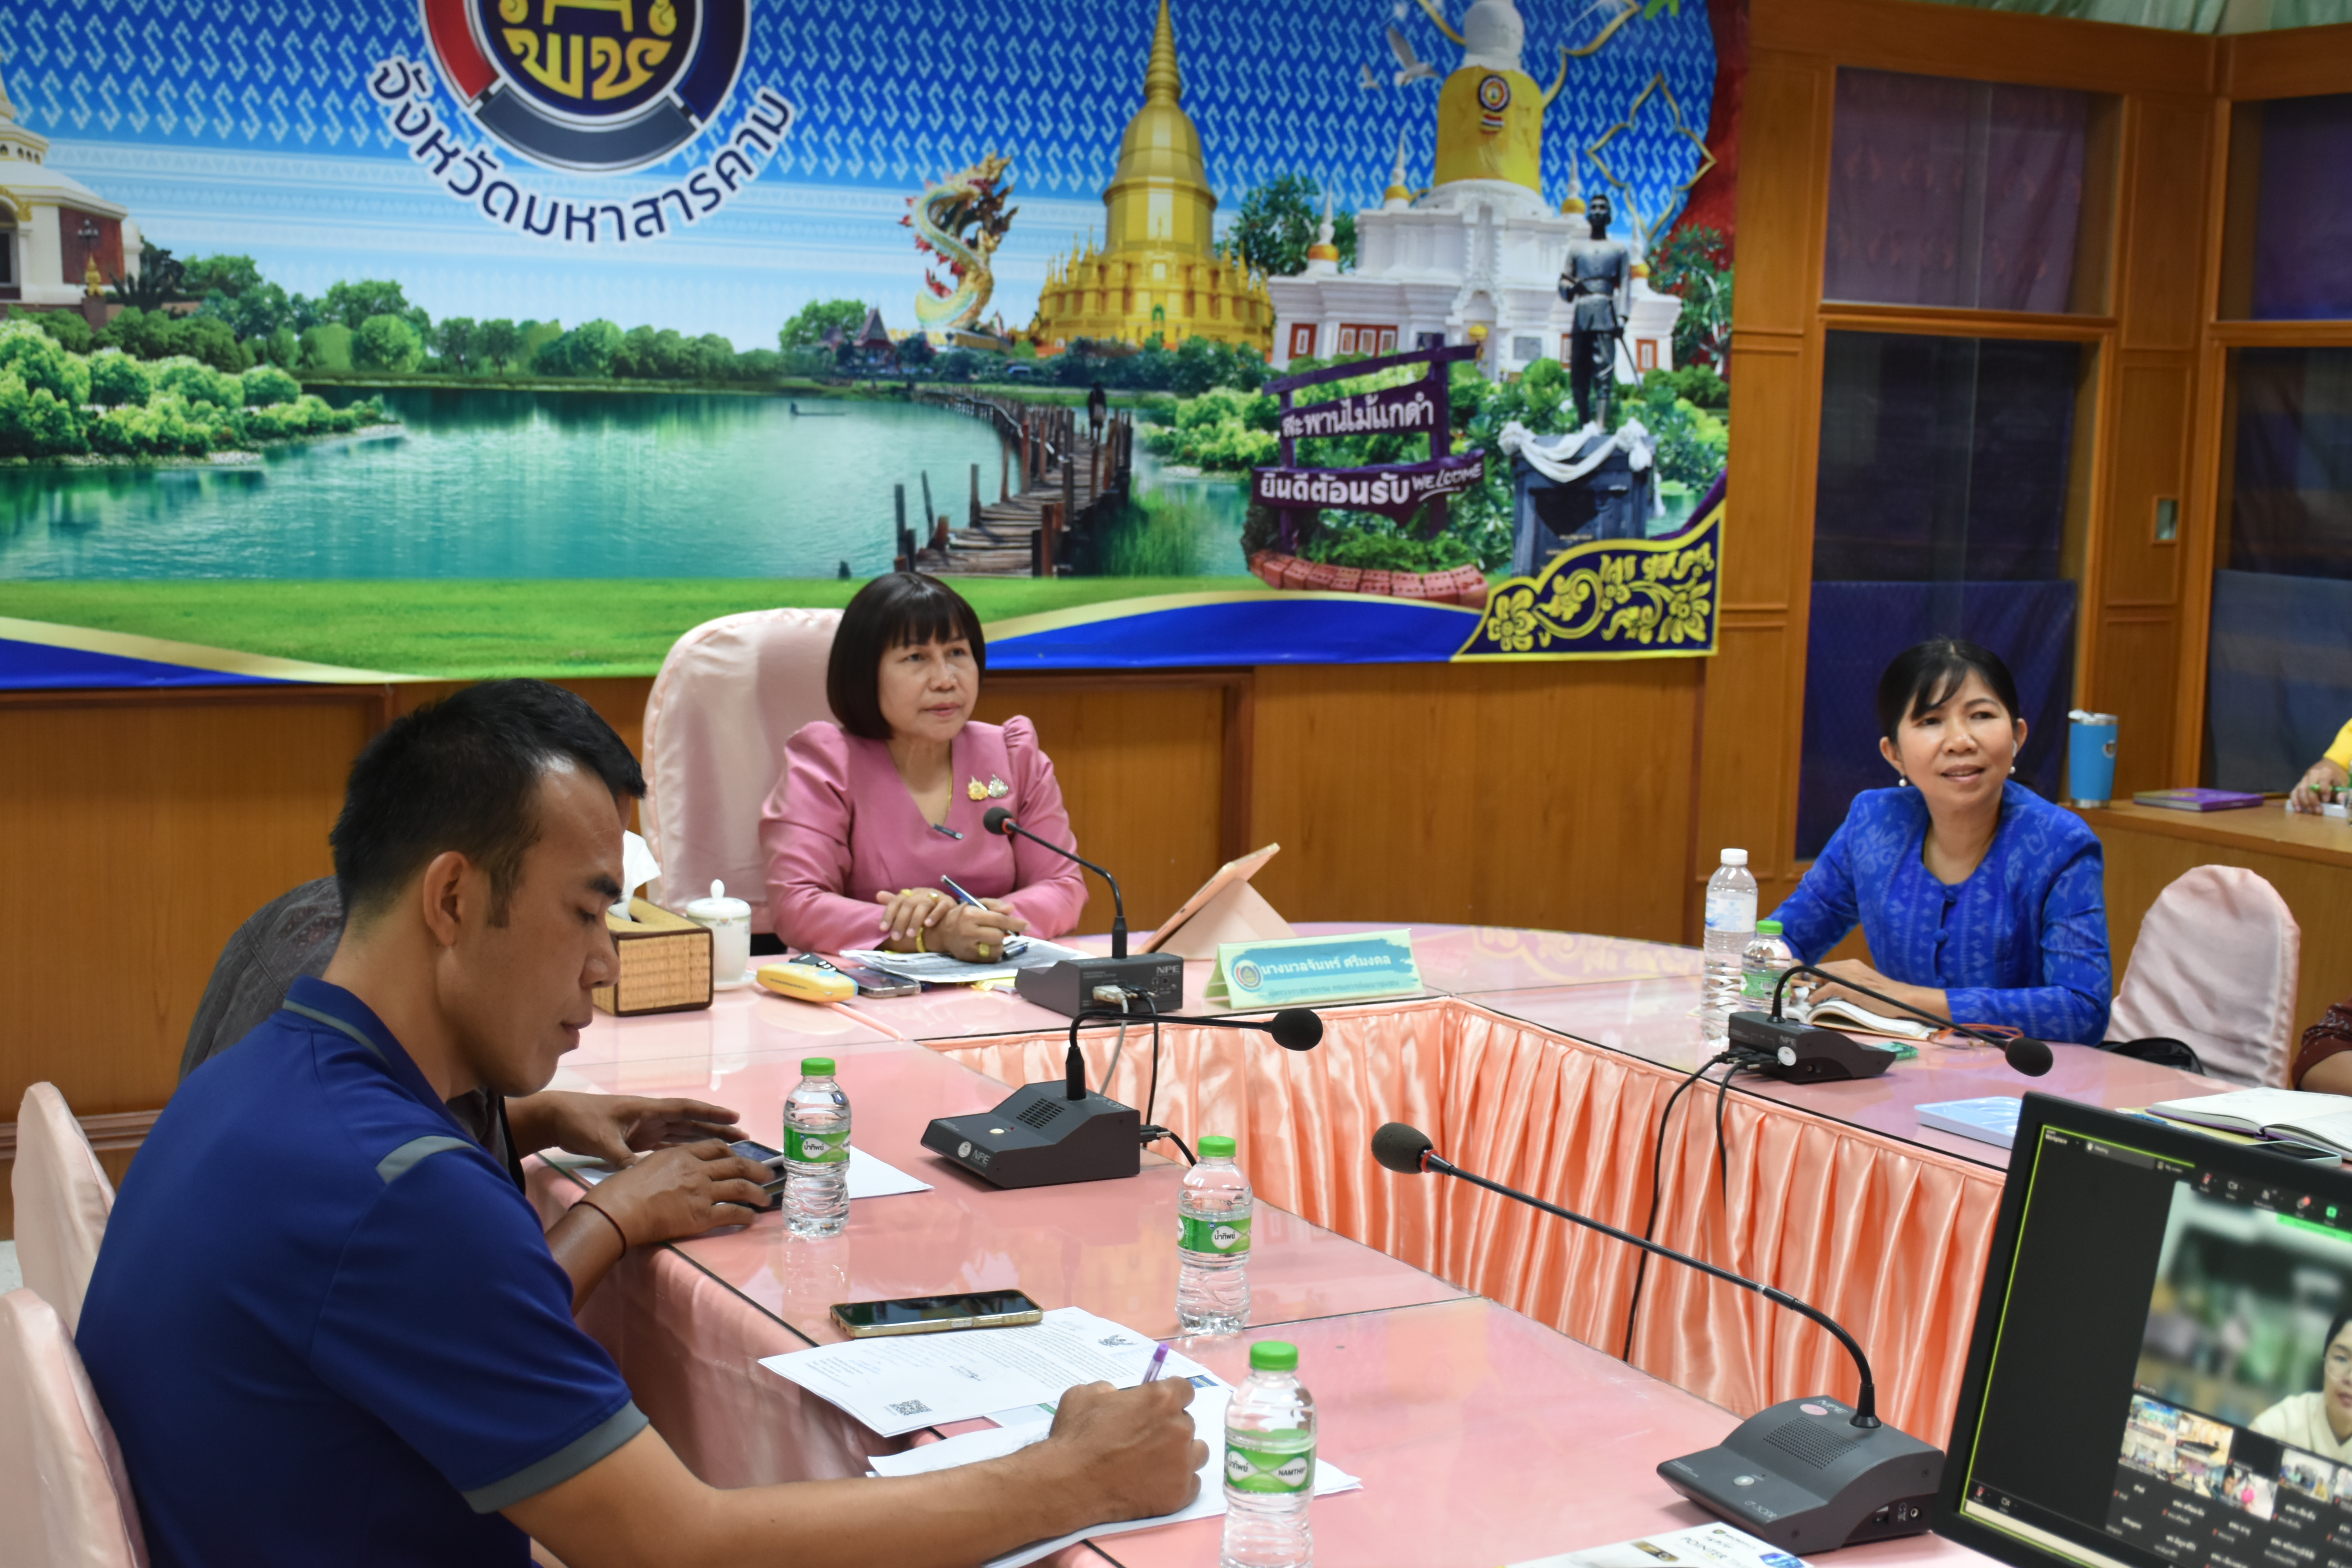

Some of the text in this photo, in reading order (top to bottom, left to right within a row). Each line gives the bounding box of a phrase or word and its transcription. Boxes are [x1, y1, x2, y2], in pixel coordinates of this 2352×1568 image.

[372, 61, 791, 242] จังหวัดมหาสารคาม
[1281, 392, 1434, 437] สะพานไม้แกดำ
[1260, 472, 1410, 505] ยินดีต้อนรับ
[1156, 965, 1180, 974] NPE
[804, 1141, 824, 1151] น้ำทิพย์
[972, 1149, 991, 1165] NPE
[1214, 1230, 1236, 1240] น้ำทิพย์
[1229, 1455, 1249, 1472] น้ำทิพย์
[1278, 1467, 1306, 1476] NAMTHIP
